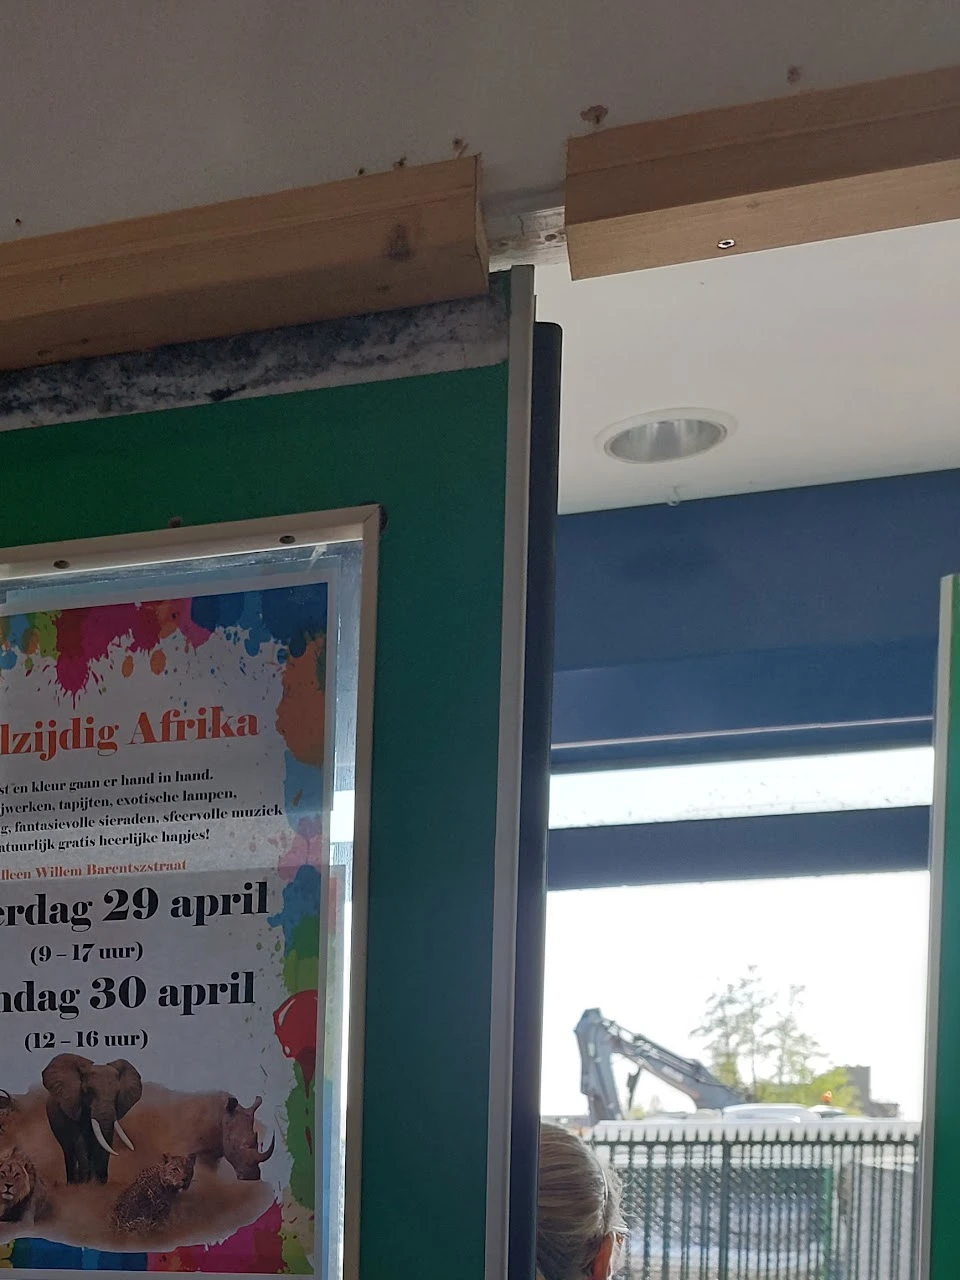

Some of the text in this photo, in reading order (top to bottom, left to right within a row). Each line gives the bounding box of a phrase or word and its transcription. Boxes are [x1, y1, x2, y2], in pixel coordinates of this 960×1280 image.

[126, 706, 260, 745] Afrika
[13, 785, 28, 795] en
[31, 781, 66, 793] kleur
[69, 779, 101, 793] gaan
[103, 778, 118, 788] er
[121, 772, 155, 787] hand
[158, 771, 172, 784] in
[175, 769, 214, 783] hand.
[59, 796, 113, 812] tapijten,
[116, 791, 179, 807] exotische
[182, 789, 237, 803] lampen,
[15, 816, 95, 834] fantasievolle
[98, 812, 160, 828] sieraden,
[163, 807, 228, 824] sfeervolle
[231, 804, 283, 818] muziek
[58, 835, 96, 851] gratis
[98, 832, 158, 847] heerlijke
[161, 828, 210, 844] hapjes!
[36, 865, 82, 880] Willem
[87, 859, 187, 878] Barentszstraat
[102, 887, 159, 922] 29
[170, 881, 269, 926] april
[30, 945, 52, 966] (9
[72, 943, 96, 963] 17
[99, 941, 144, 962] uur)
[89, 975, 147, 1010] 30
[158, 971, 256, 1016] april
[24, 1031, 56, 1053] (12
[74, 1030, 99, 1048] 16
[104, 1028, 149, 1050] uur)
